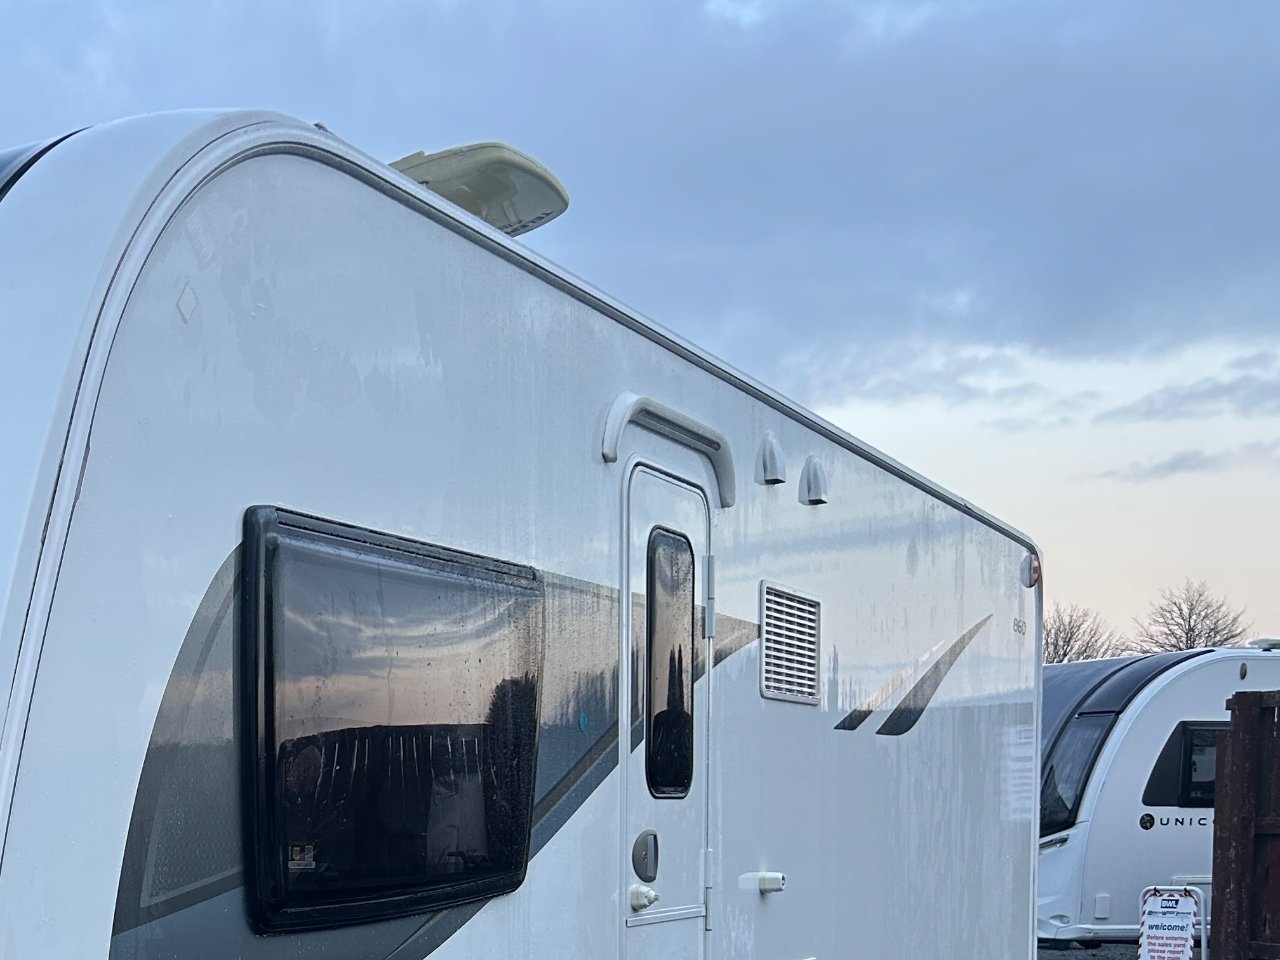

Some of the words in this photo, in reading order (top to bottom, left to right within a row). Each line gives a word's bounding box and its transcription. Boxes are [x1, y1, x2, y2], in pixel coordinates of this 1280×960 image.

[1160, 817, 1215, 827] UNIC
[1161, 900, 1177, 908] BWL
[1148, 922, 1189, 932] welcome!
